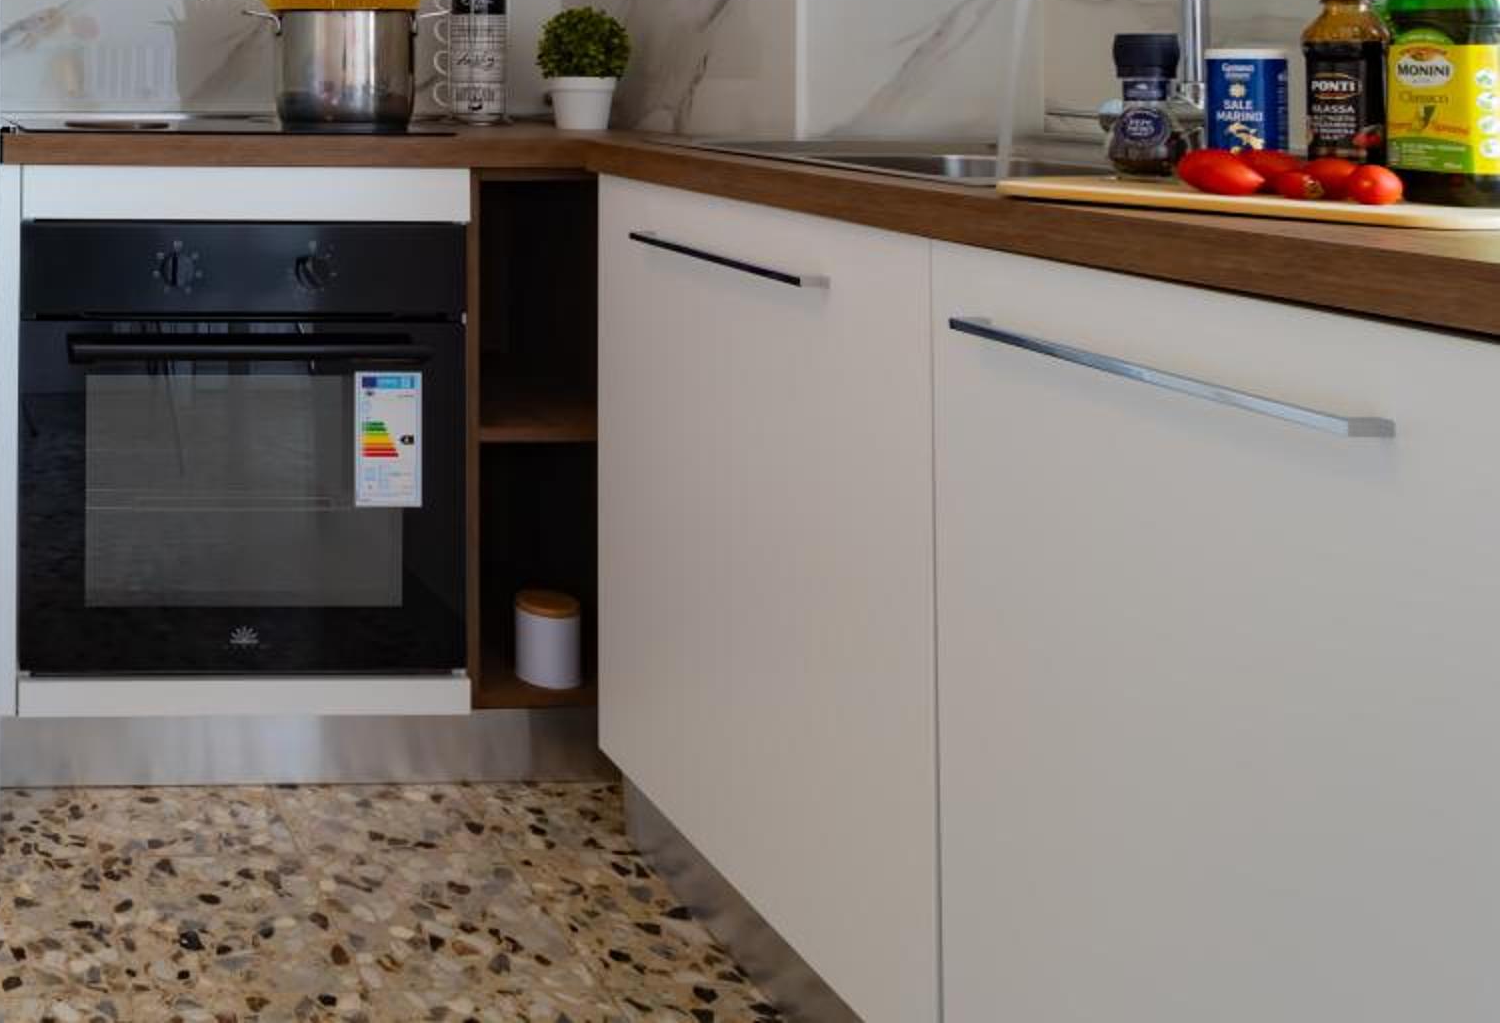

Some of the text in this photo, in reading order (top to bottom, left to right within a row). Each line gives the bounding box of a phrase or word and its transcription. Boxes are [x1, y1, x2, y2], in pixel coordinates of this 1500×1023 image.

[1396, 64, 1451, 77] MONINI
[1311, 80, 1356, 92] PONTI
[1223, 100, 1253, 110] SALE
[1216, 111, 1263, 122] MARINO
